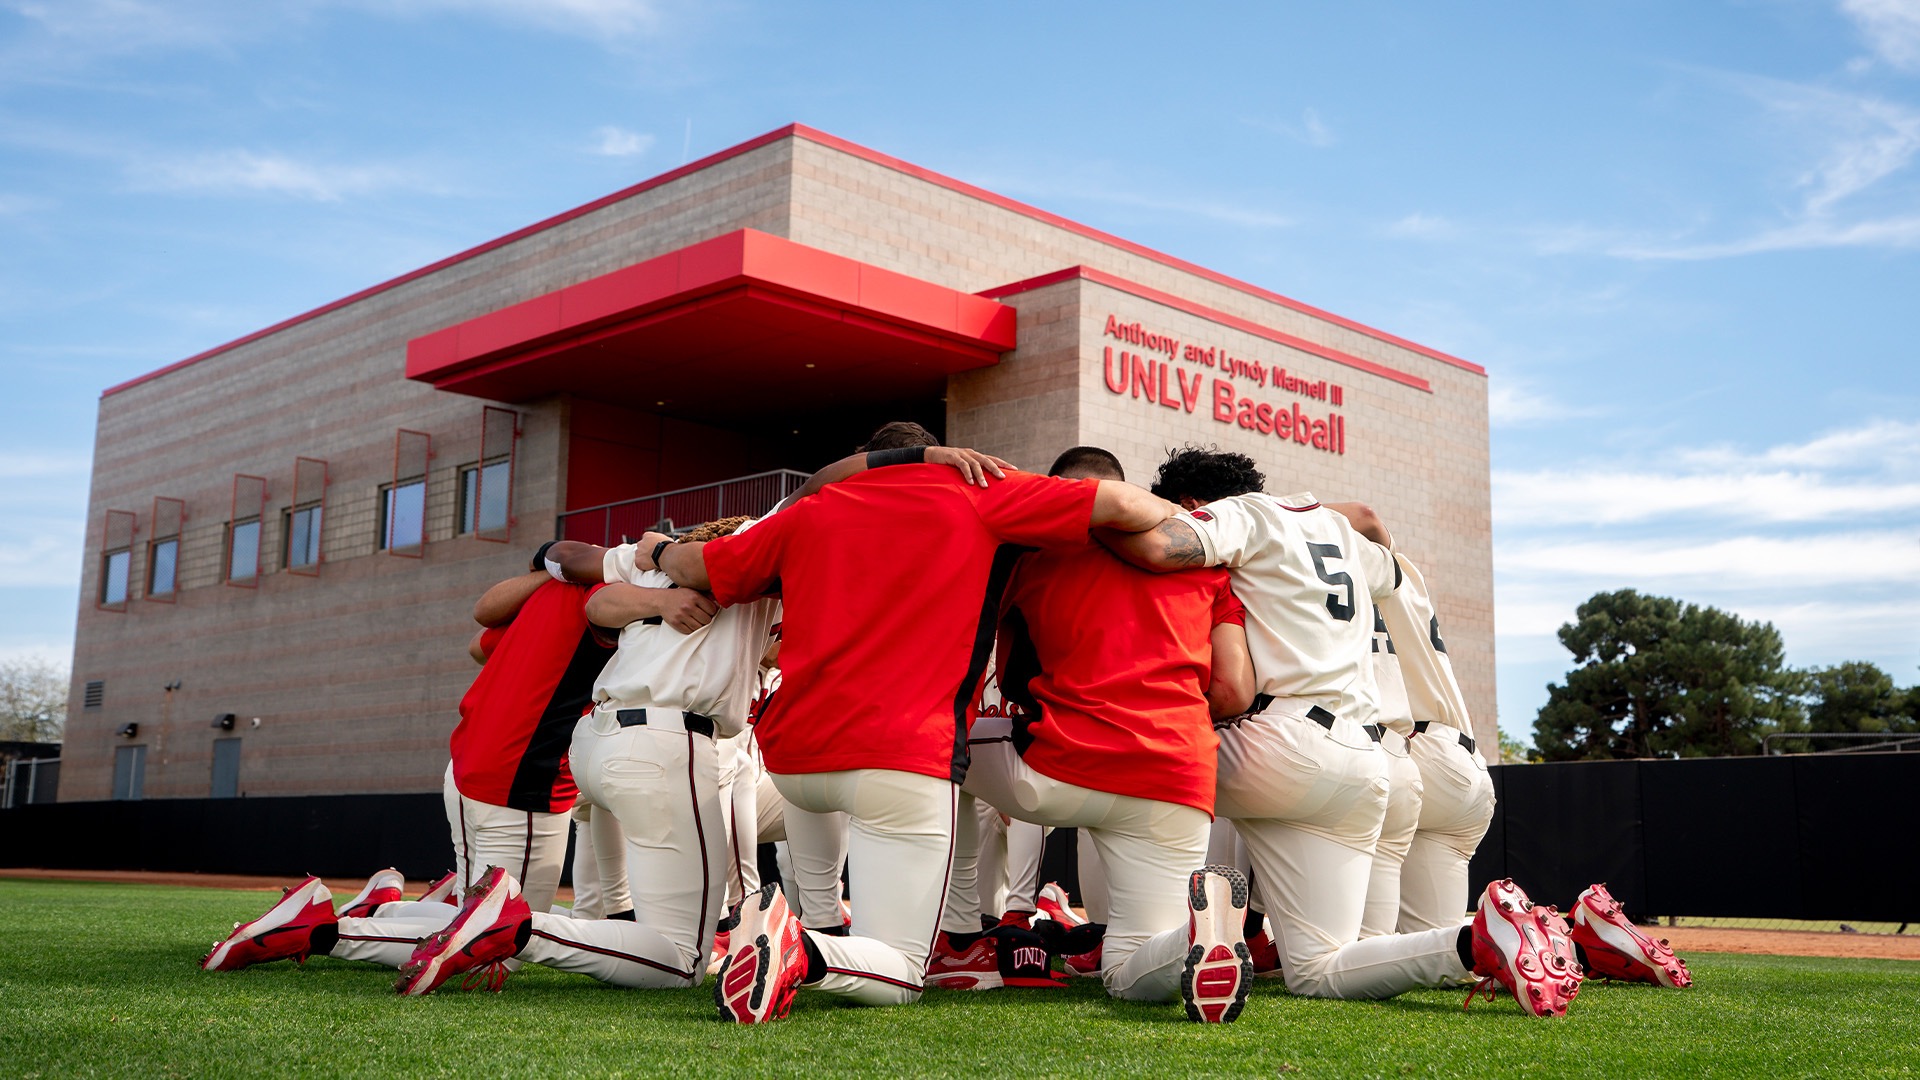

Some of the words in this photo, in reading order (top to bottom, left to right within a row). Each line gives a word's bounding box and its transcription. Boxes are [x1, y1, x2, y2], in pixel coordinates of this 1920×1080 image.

[1104, 314, 1180, 361] Anthony
[1184, 344, 1216, 368] and
[1220, 349, 1269, 388] Lyndy
[1273, 365, 1328, 401] Marnell
[1331, 384, 1344, 407] III
[1104, 346, 1203, 413] UNLV
[1213, 378, 1345, 455] Baseball
[1306, 541, 1356, 622] 5
[1013, 947, 1047, 971] UNLV
